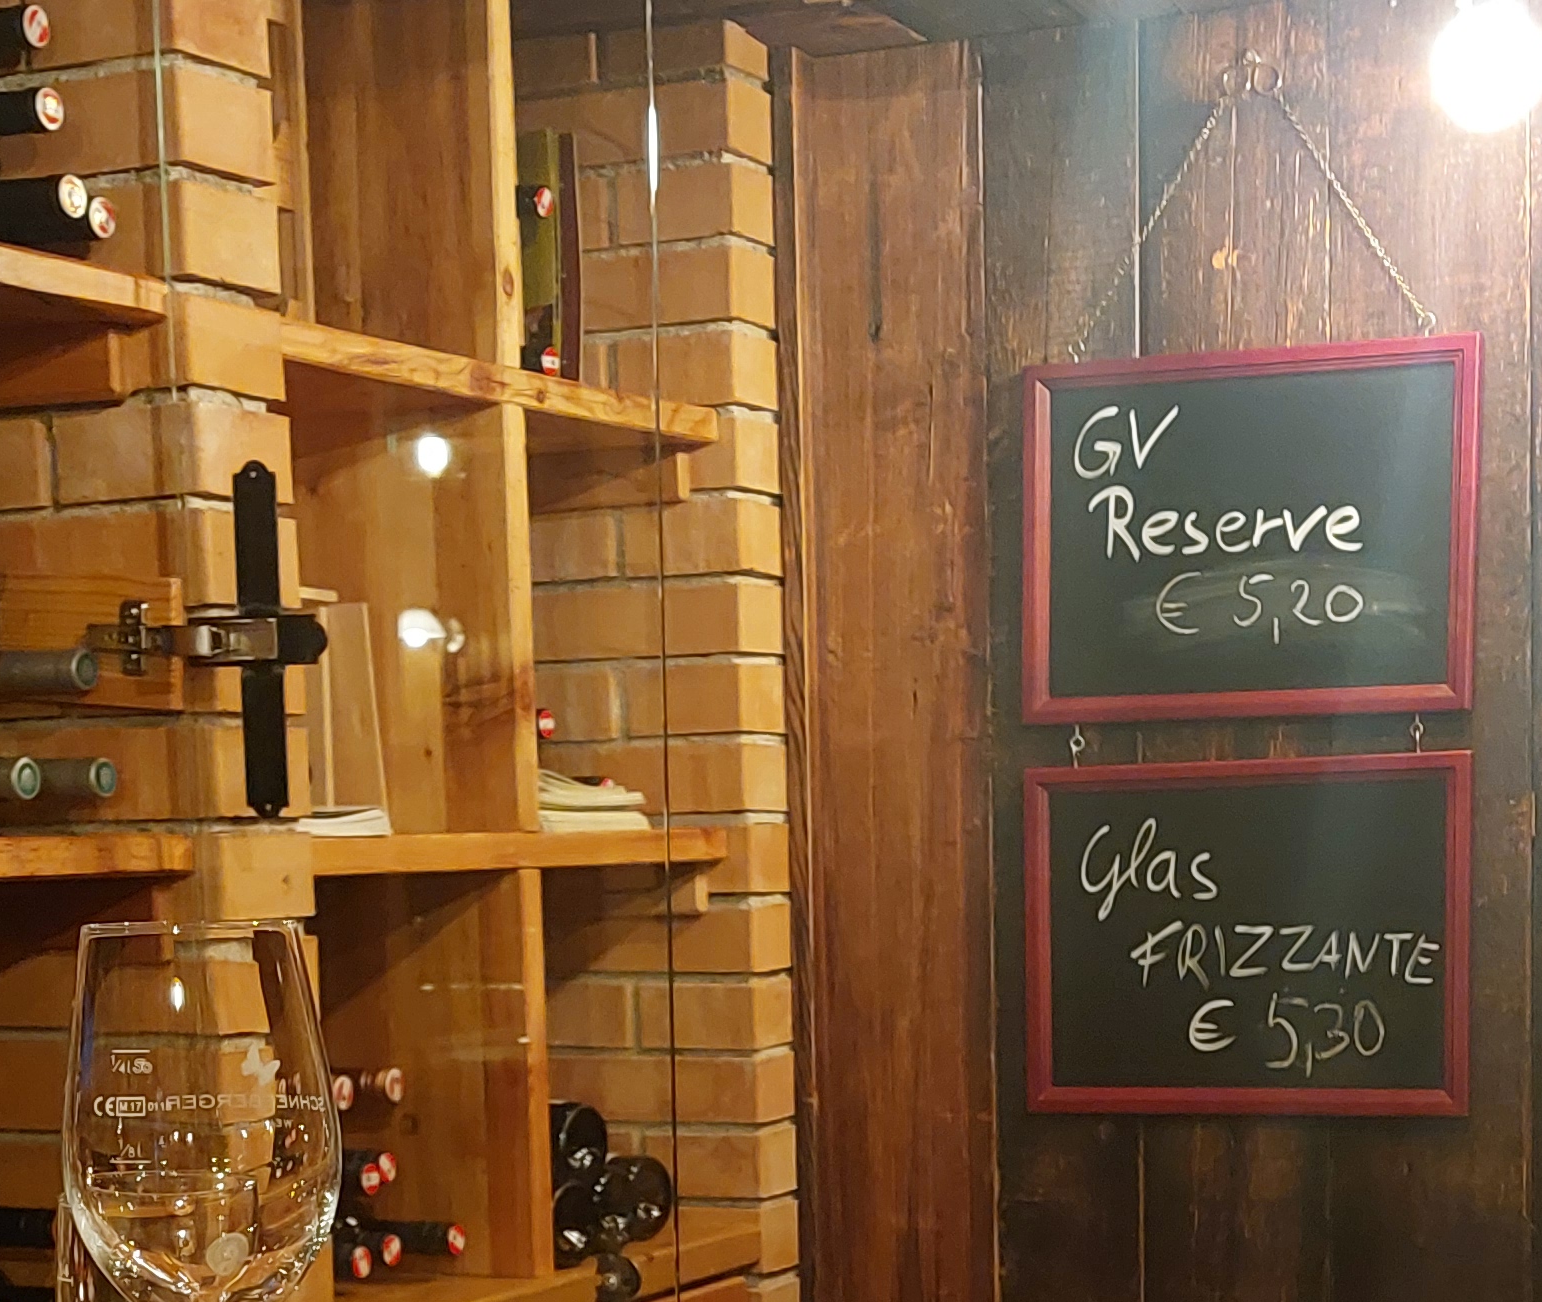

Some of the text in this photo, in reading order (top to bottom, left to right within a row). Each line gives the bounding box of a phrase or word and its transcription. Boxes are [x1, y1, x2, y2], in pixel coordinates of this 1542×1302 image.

[1074, 404, 1179, 479] GV
[1088, 485, 1363, 563] Reserve
[1156, 571, 1364, 644] € 5,20
[1081, 817, 1218, 921] Glas
[1130, 920, 1440, 990] FRIZZANTE
[1188, 992, 1385, 1078] € 5,30
